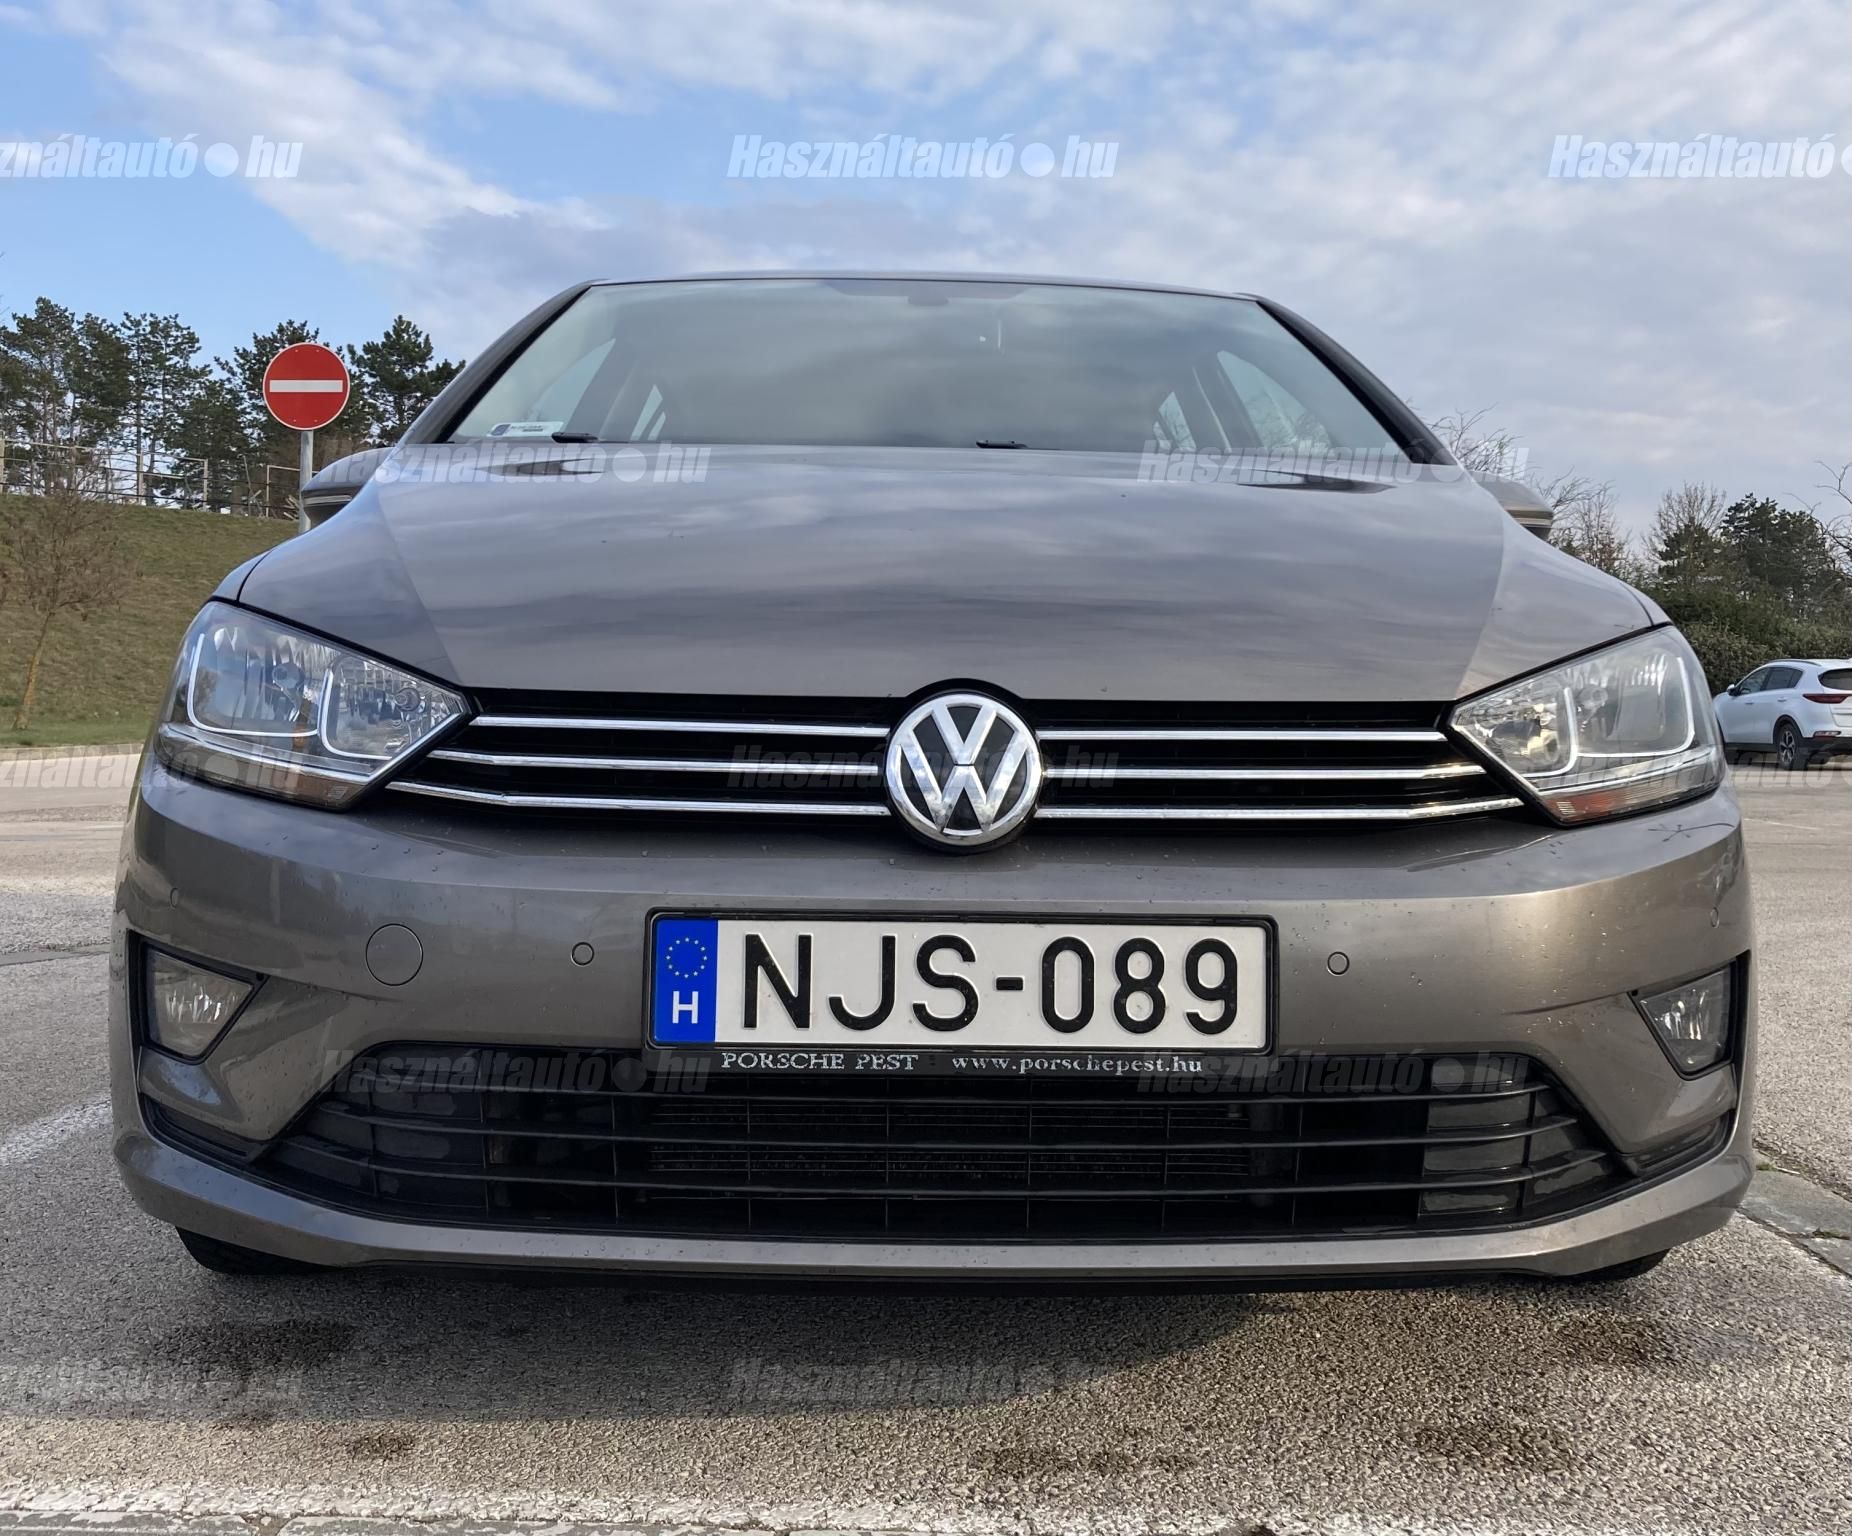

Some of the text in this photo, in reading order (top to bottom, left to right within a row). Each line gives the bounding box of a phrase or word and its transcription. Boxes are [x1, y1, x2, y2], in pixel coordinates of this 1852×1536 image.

[742, 933, 1239, 1035] NJS-089
[672, 991, 699, 1024] H
[721, 1052, 1204, 1076] PORSCHE PEST www.porschepest.hu
